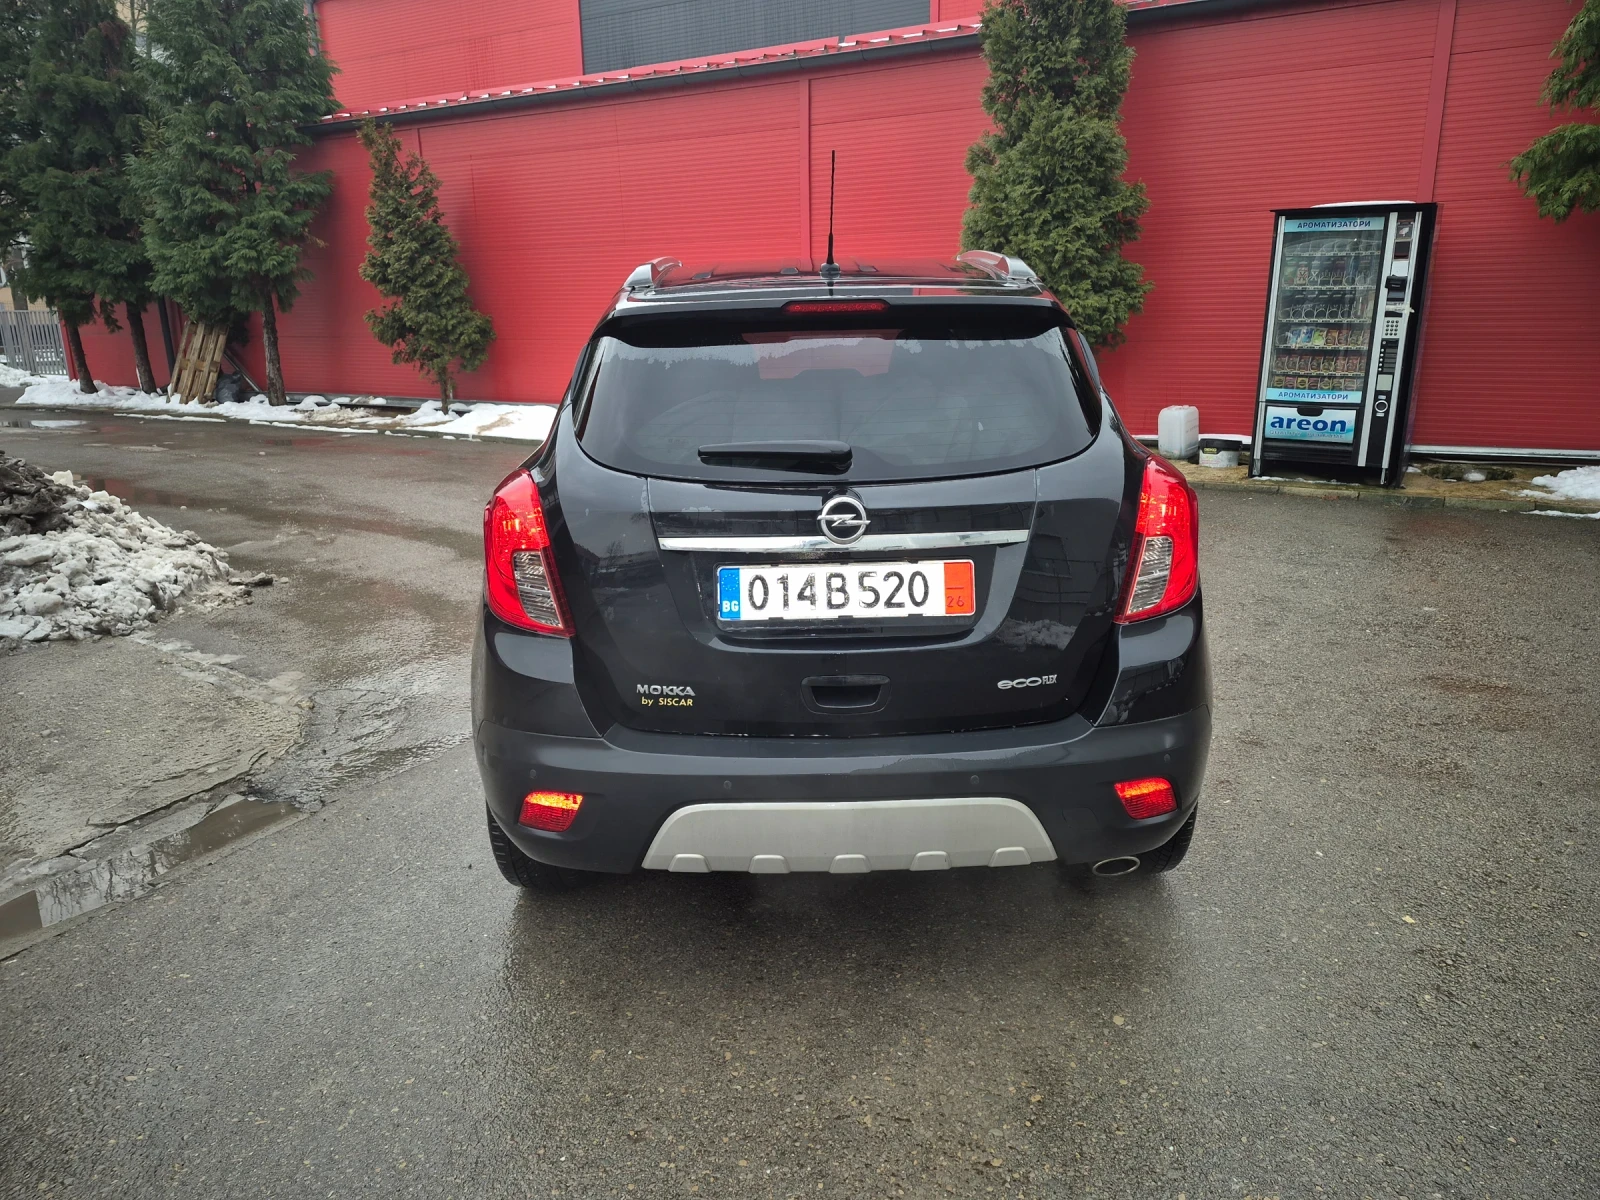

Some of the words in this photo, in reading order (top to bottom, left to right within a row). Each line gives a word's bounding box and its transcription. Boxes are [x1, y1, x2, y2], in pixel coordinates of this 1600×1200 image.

[1297, 220, 1371, 229] АРОМАТИЗАТОРИ
[1278, 391, 1349, 400] АРОМАТИЗАТОРИ
[1270, 416, 1347, 432] areon
[748, 570, 930, 611] 014B520
[722, 600, 739, 613] BG
[946, 595, 965, 608] 26
[636, 684, 696, 697] MOKKA
[641, 696, 654, 706] by
[658, 697, 693, 706] SISCAR
